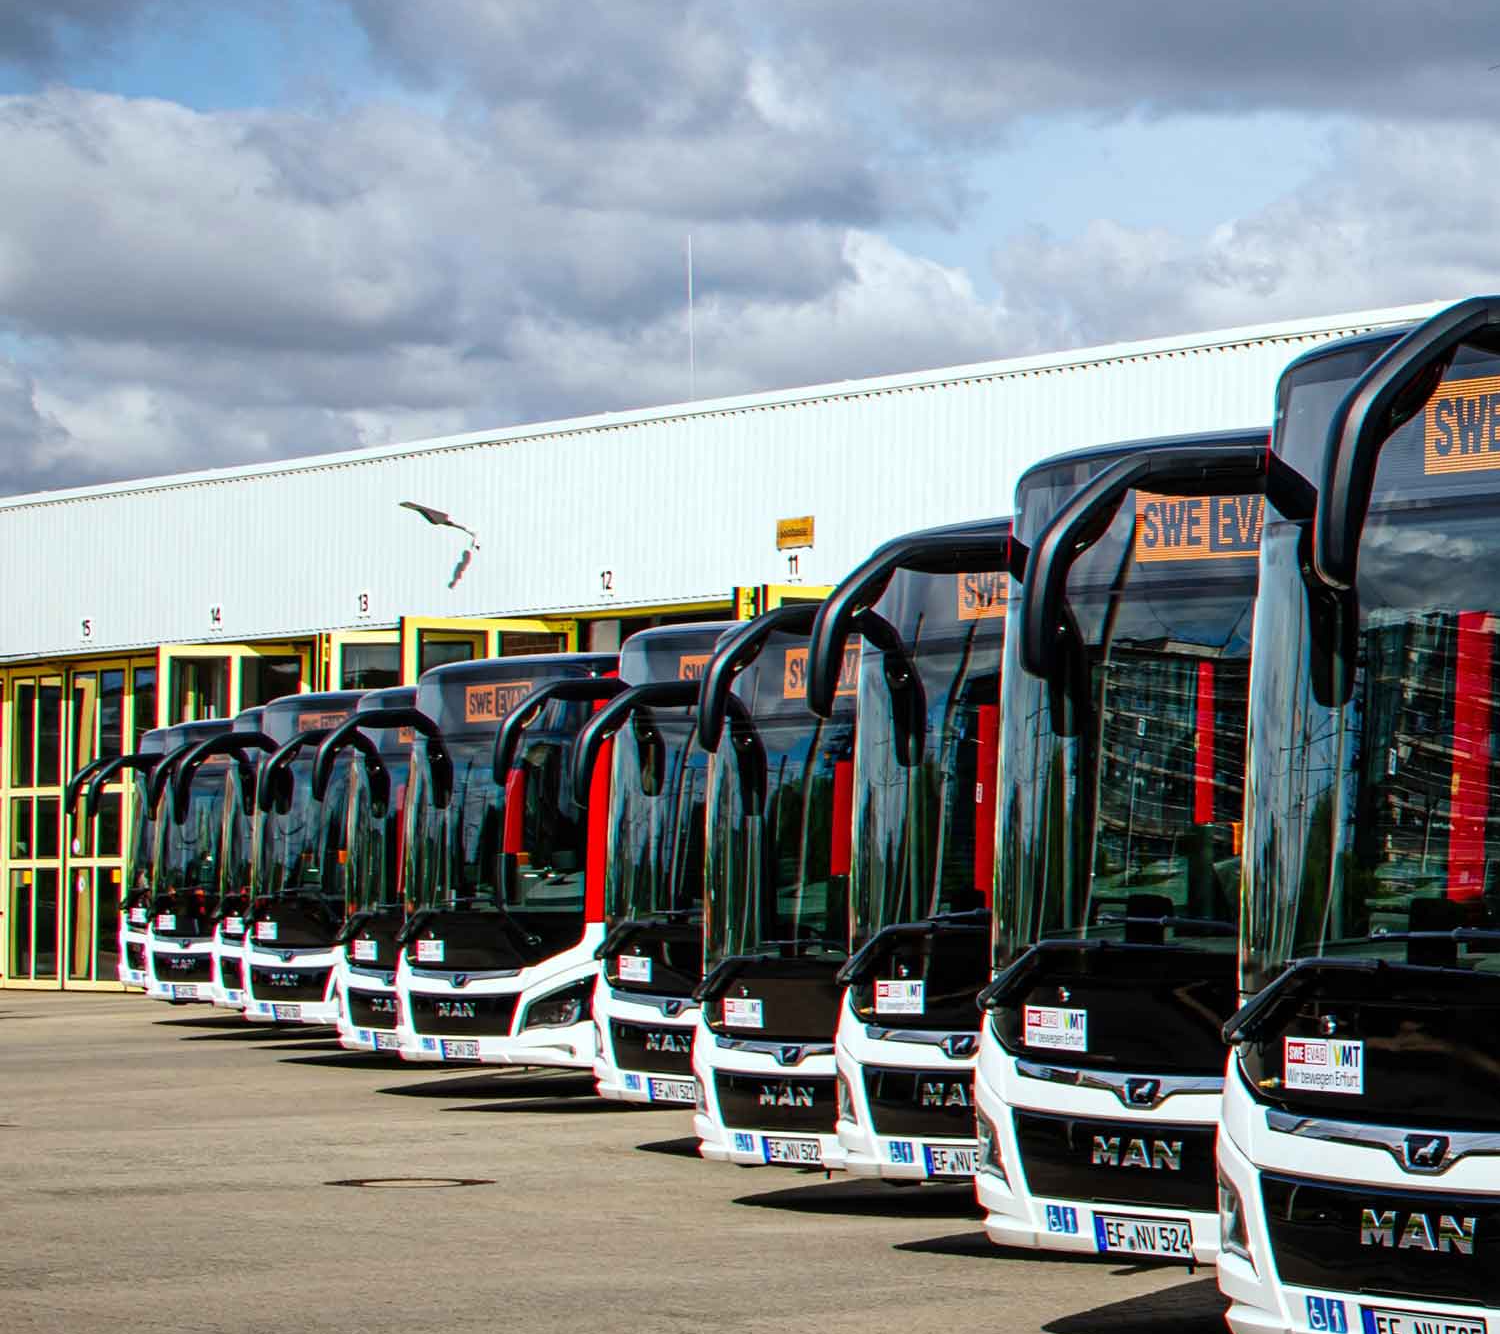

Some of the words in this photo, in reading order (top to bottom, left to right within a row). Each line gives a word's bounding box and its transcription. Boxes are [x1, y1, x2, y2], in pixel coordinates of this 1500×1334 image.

[1143, 500, 1202, 548] SWE
[788, 554, 799, 575] 11
[600, 570, 613, 590] 12
[358, 593, 369, 612] 13
[211, 607, 221, 624] 14
[82, 619, 91, 636] 15
[469, 691, 493, 716] SWE
[1063, 1012, 1084, 1030] VMT
[646, 1033, 691, 1052] MAN
[1332, 1044, 1361, 1067] VMT
[759, 1084, 815, 1107] MAN
[933, 1150, 947, 1171] EF
[1091, 1135, 1183, 1170] MAN
[1106, 1222, 1125, 1247] EF
[1135, 1224, 1156, 1250] NV
[1160, 1227, 1190, 1253] 524
[1360, 1208, 1477, 1255] MAN
